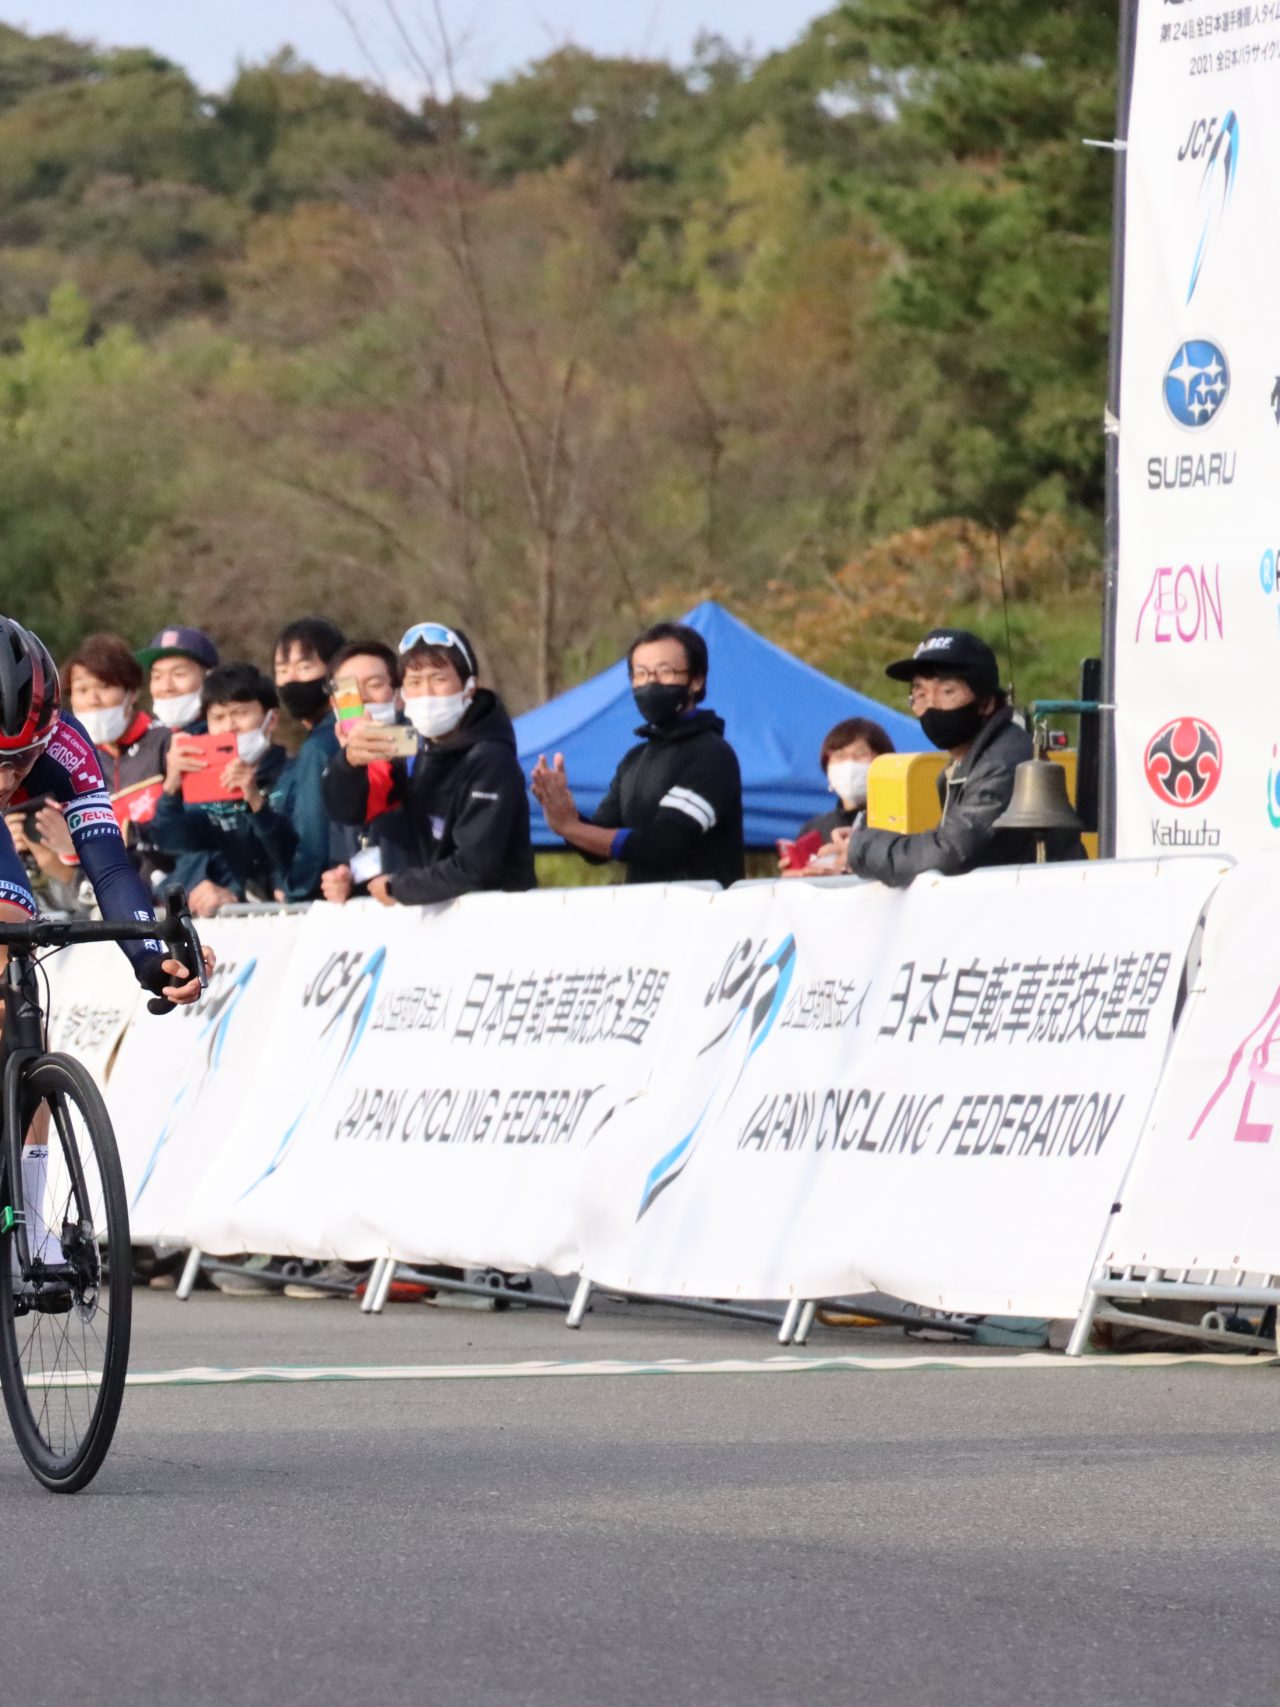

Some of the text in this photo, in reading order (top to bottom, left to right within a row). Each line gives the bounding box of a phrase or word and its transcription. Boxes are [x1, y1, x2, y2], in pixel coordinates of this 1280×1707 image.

[1177, 117, 1218, 162] JCF
[1147, 452, 1237, 490] SUBARU
[1152, 818, 1221, 848] Kabuto
[333, 1087, 408, 1141] JAPAN
[400, 1087, 501, 1144] CYCLING
[736, 1087, 1125, 1157] JAPAN CYCLING FEDERATION
